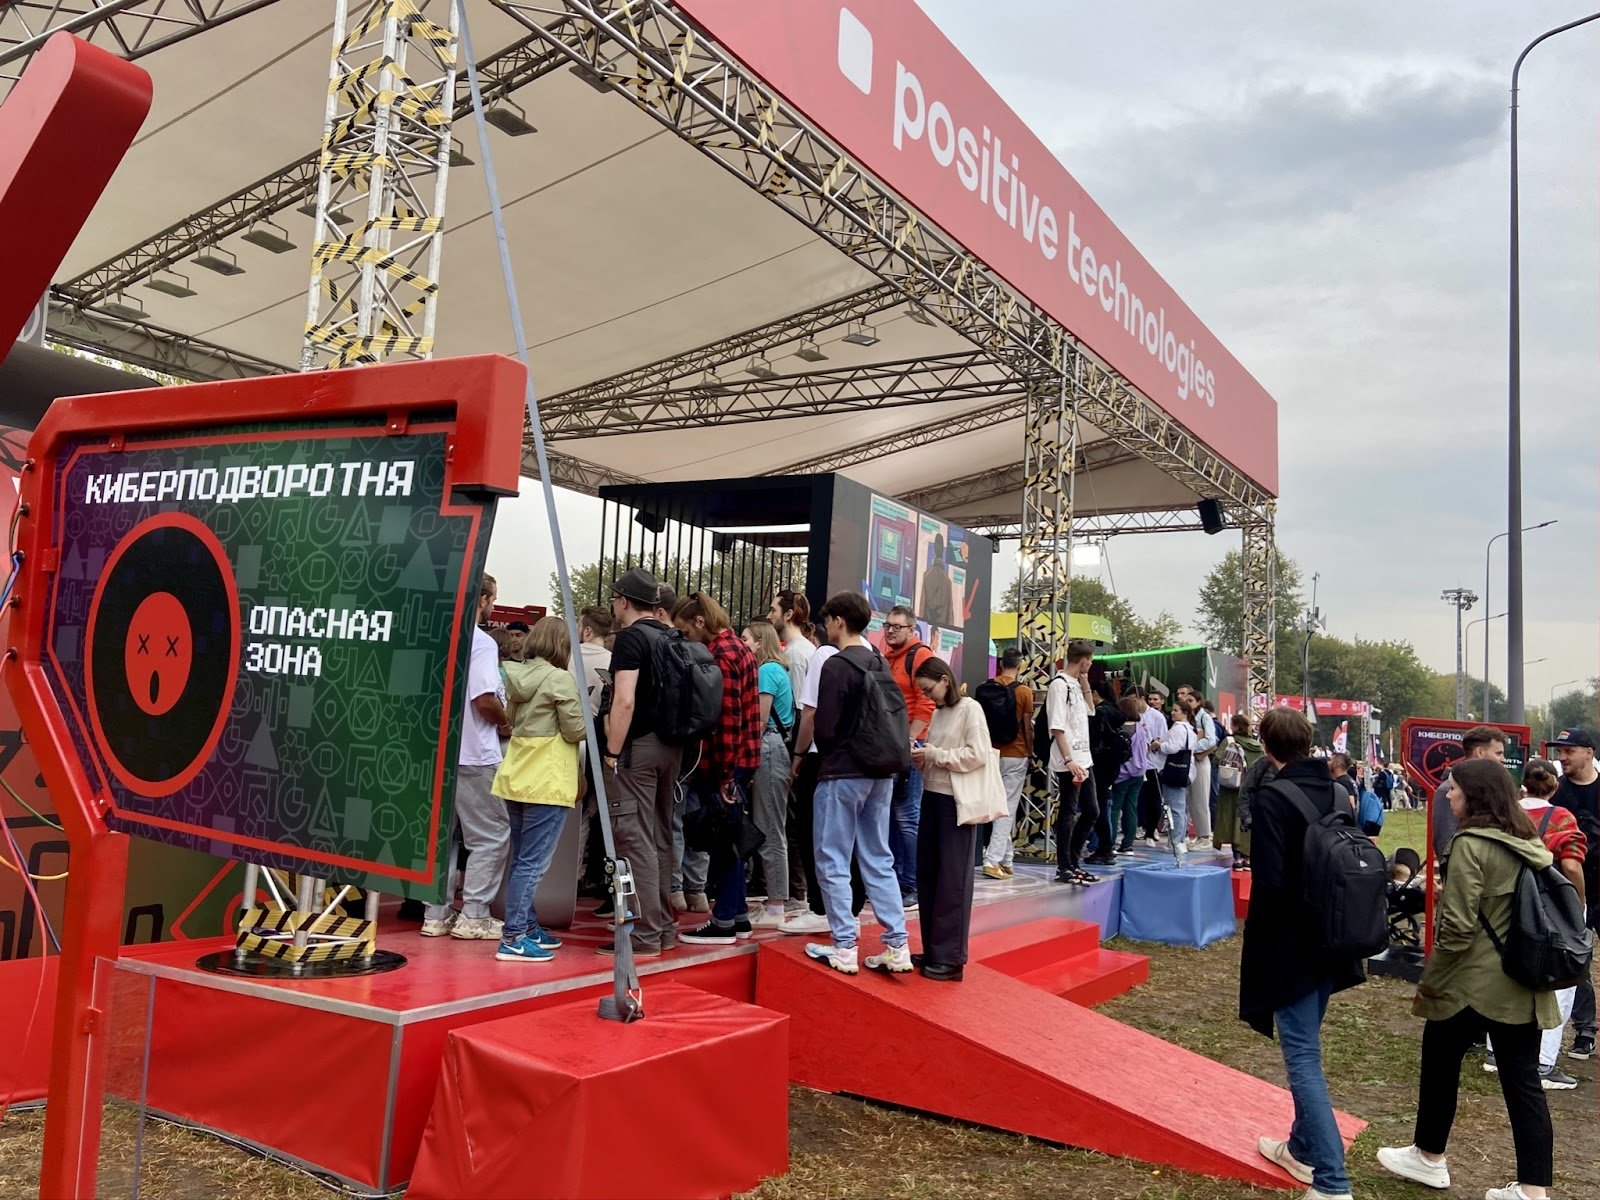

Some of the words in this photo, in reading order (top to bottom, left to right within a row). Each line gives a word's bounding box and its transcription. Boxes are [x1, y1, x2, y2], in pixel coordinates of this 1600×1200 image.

[892, 60, 1059, 260] positive
[1067, 211, 1216, 408] technologies
[85, 460, 415, 505] КИБЕРПОДВОРОТНЯ
[249, 605, 392, 642] ОПАСНАЯ
[245, 642, 323, 677] ЗОНА
